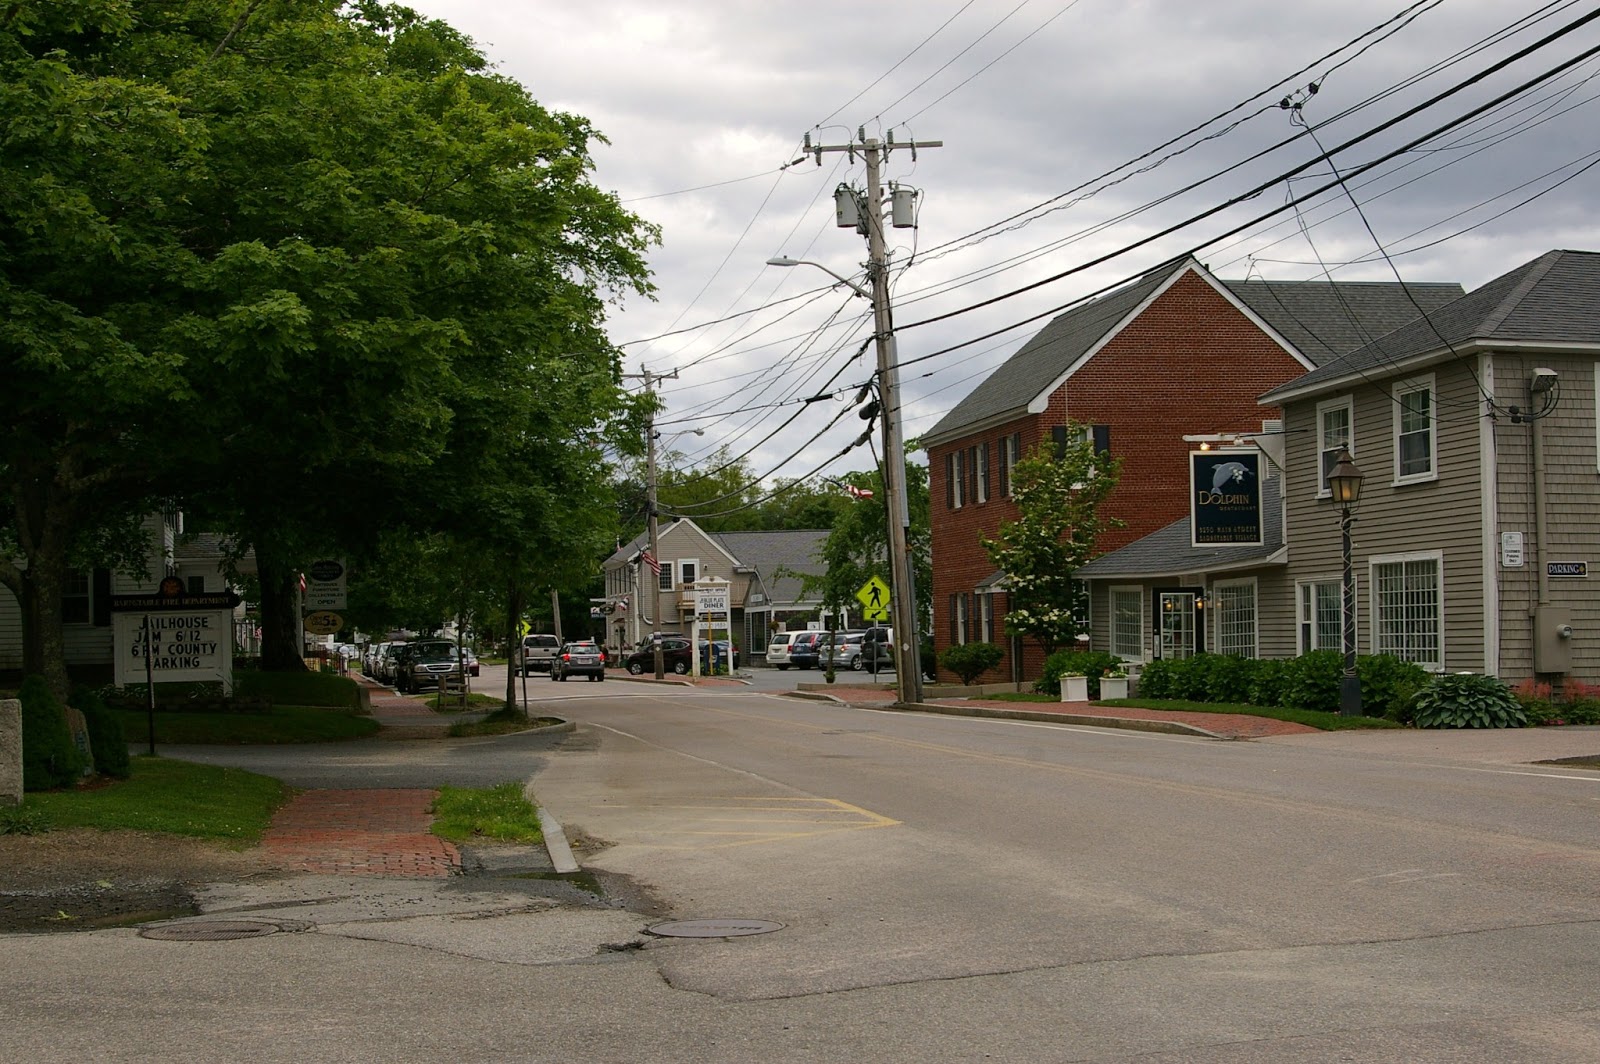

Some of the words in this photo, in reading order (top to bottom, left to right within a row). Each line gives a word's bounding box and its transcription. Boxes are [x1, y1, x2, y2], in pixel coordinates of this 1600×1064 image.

[1199, 491, 1249, 504] DOLPHIN
[1548, 564, 1579, 574] PARKING
[114, 599, 159, 607] BARNSTABLE
[182, 597, 229, 605] DEPARTMENT
[323, 615, 330, 626] 5
[131, 645, 139, 657] 6
[168, 643, 217, 655] COUNTY
